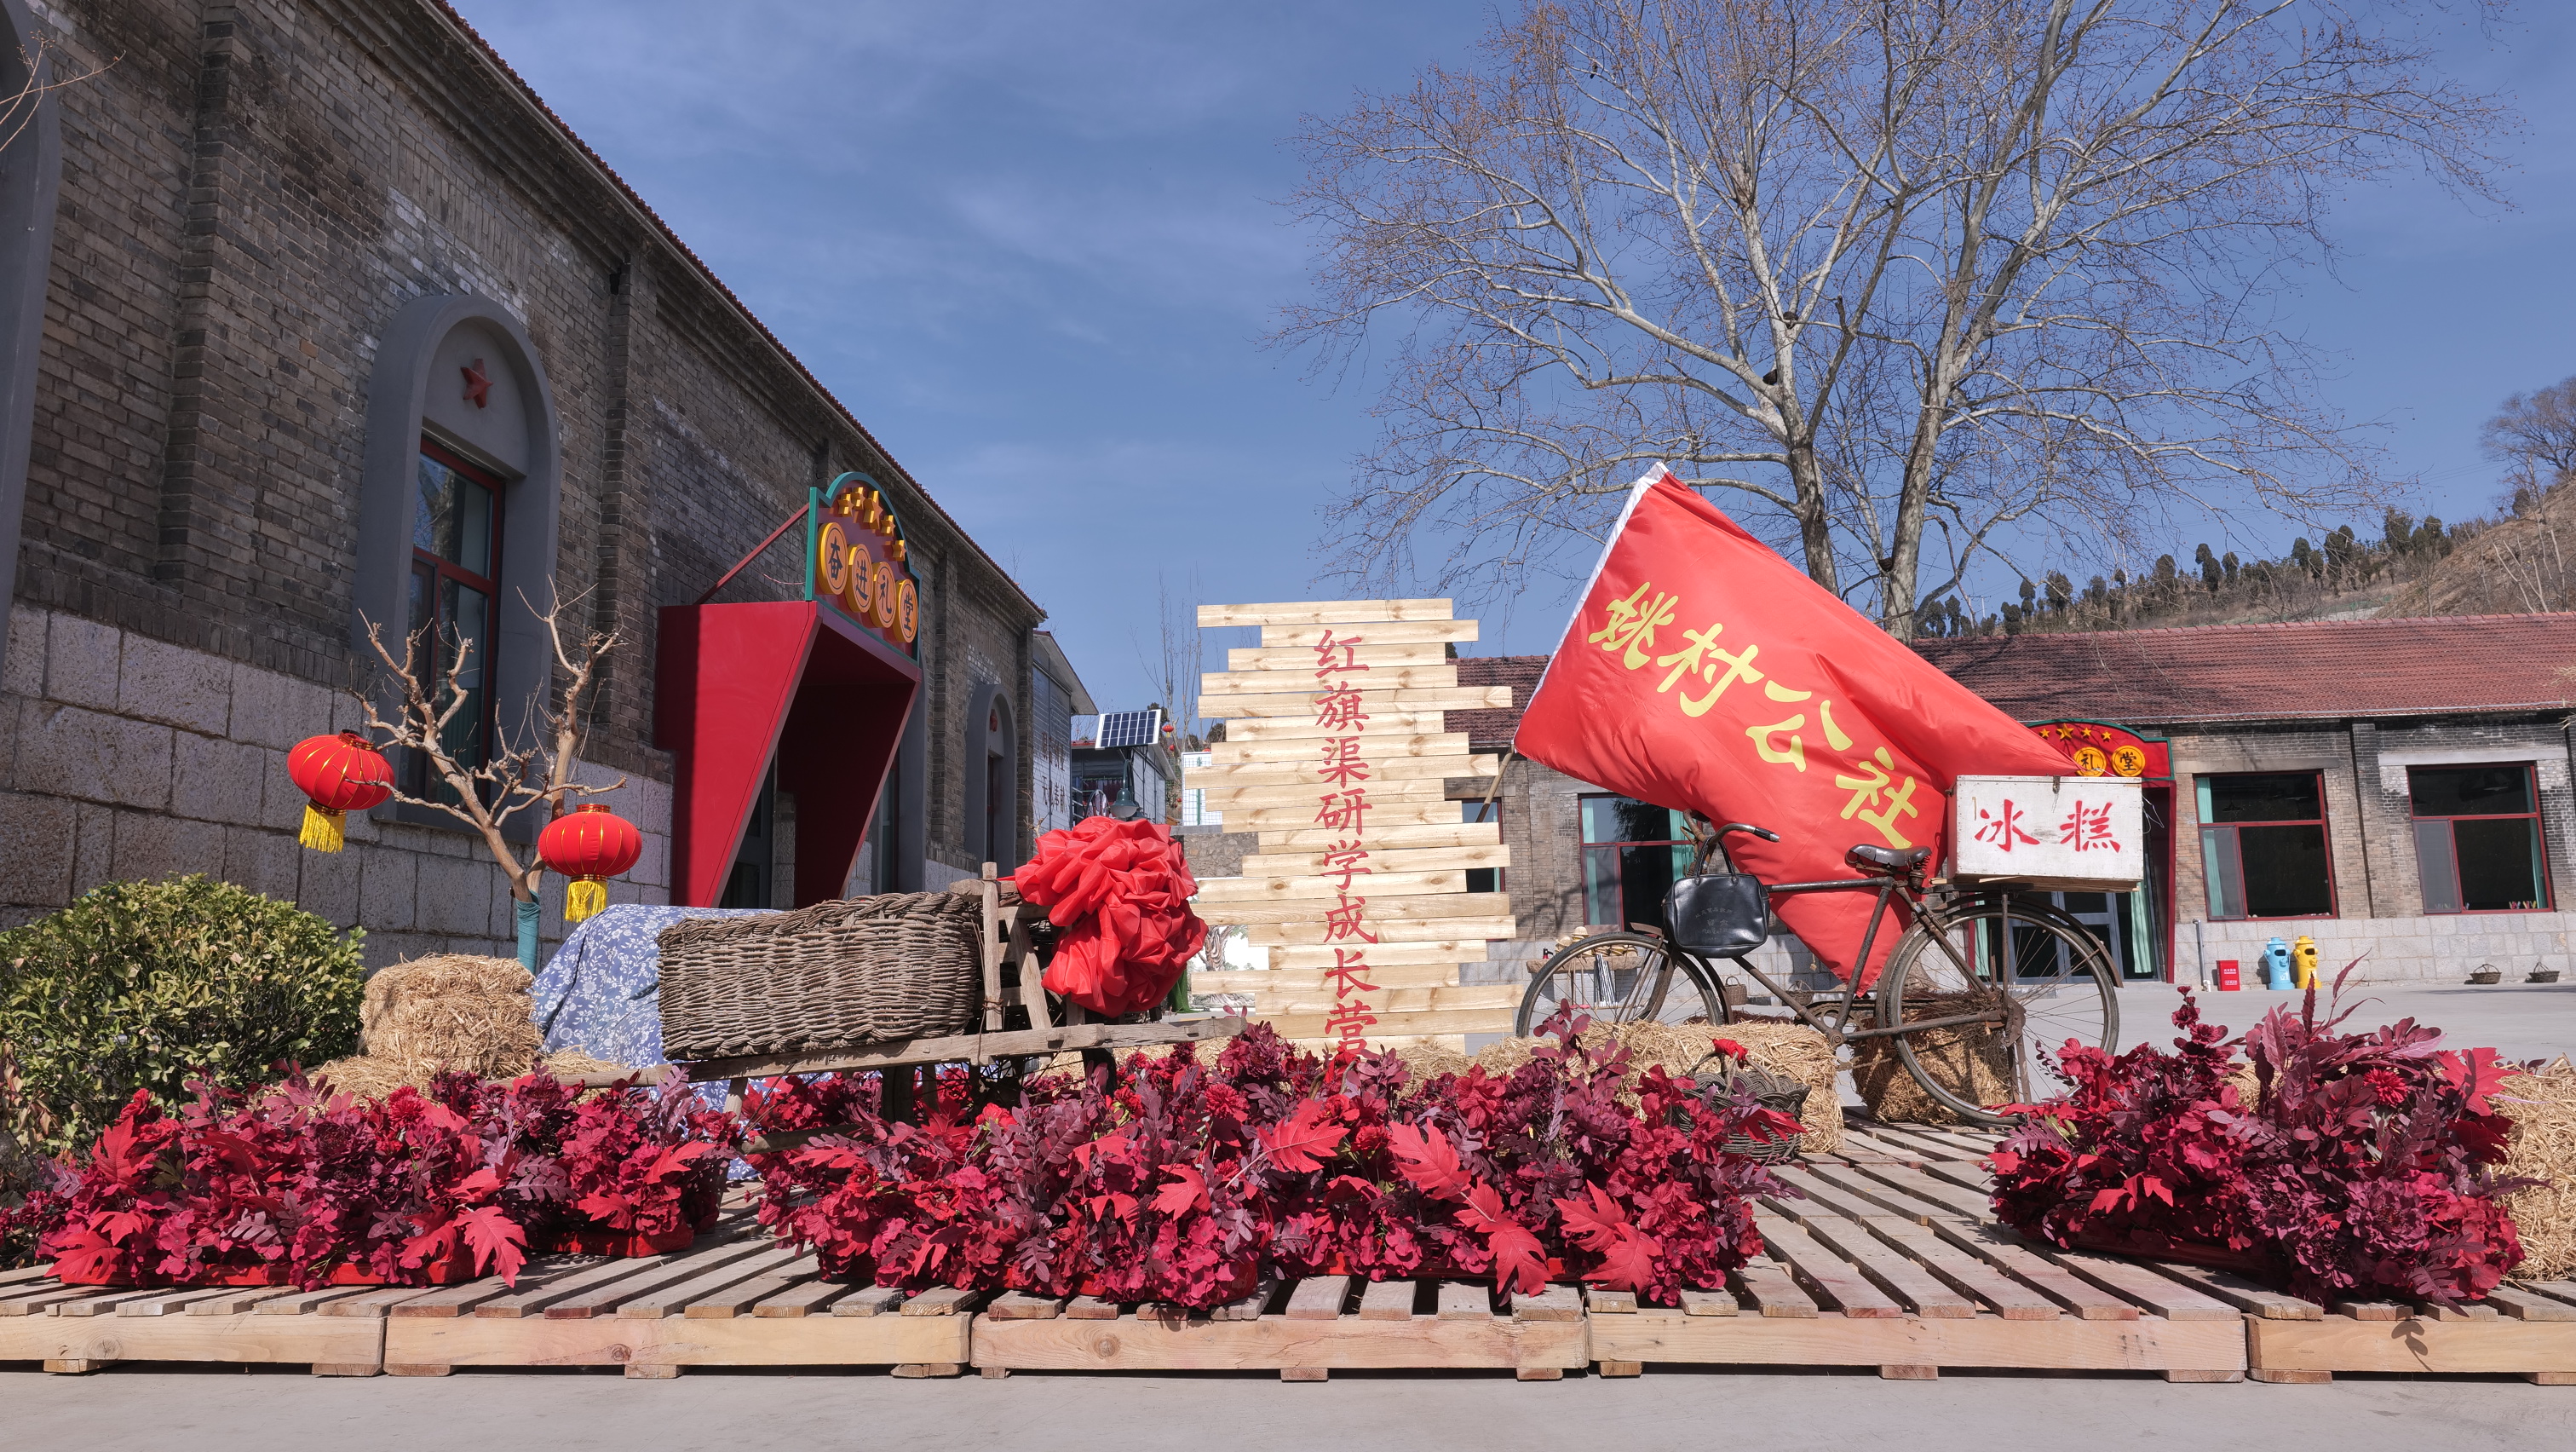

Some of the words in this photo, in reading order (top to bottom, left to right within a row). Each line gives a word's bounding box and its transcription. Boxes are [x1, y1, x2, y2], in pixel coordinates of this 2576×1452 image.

[827, 536, 914, 632] 奋进礼堂
[1589, 582, 1918, 848] 姚村公社
[1314, 629, 1381, 1056] 红旗渠研学成长营
[1975, 798, 2121, 853] 冰糕
